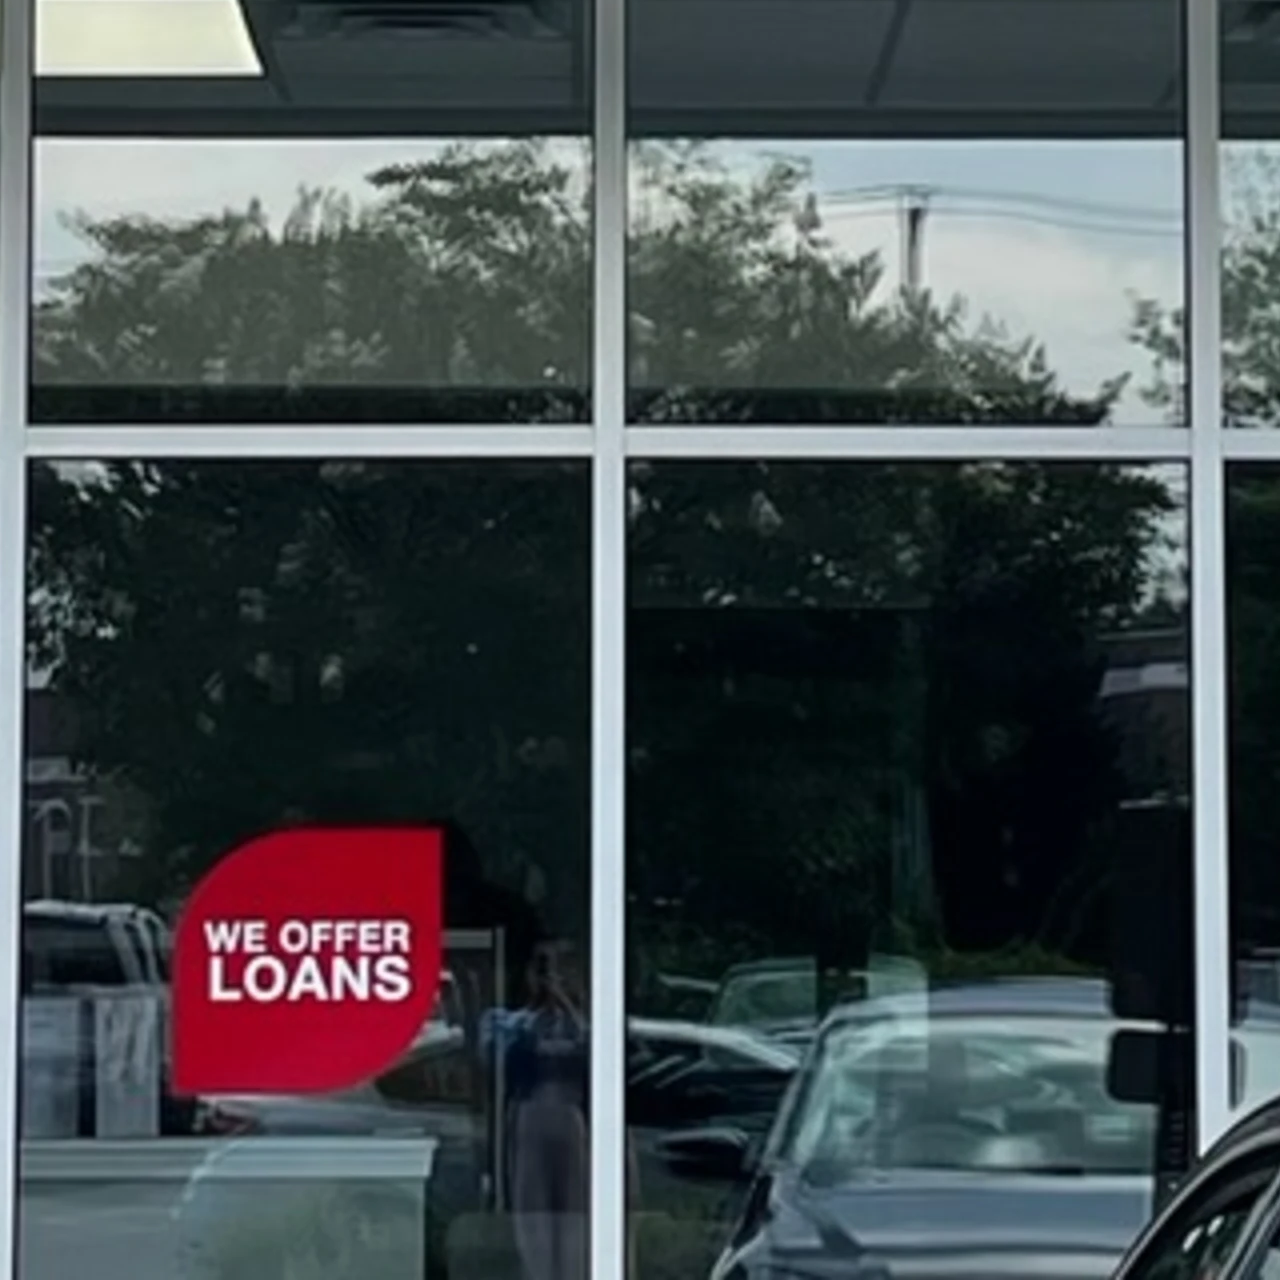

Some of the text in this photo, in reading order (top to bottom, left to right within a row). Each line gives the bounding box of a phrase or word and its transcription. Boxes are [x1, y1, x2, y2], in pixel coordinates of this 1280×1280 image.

[204, 920, 410, 953] WE OFFER
[209, 955, 411, 1002] LOANS
